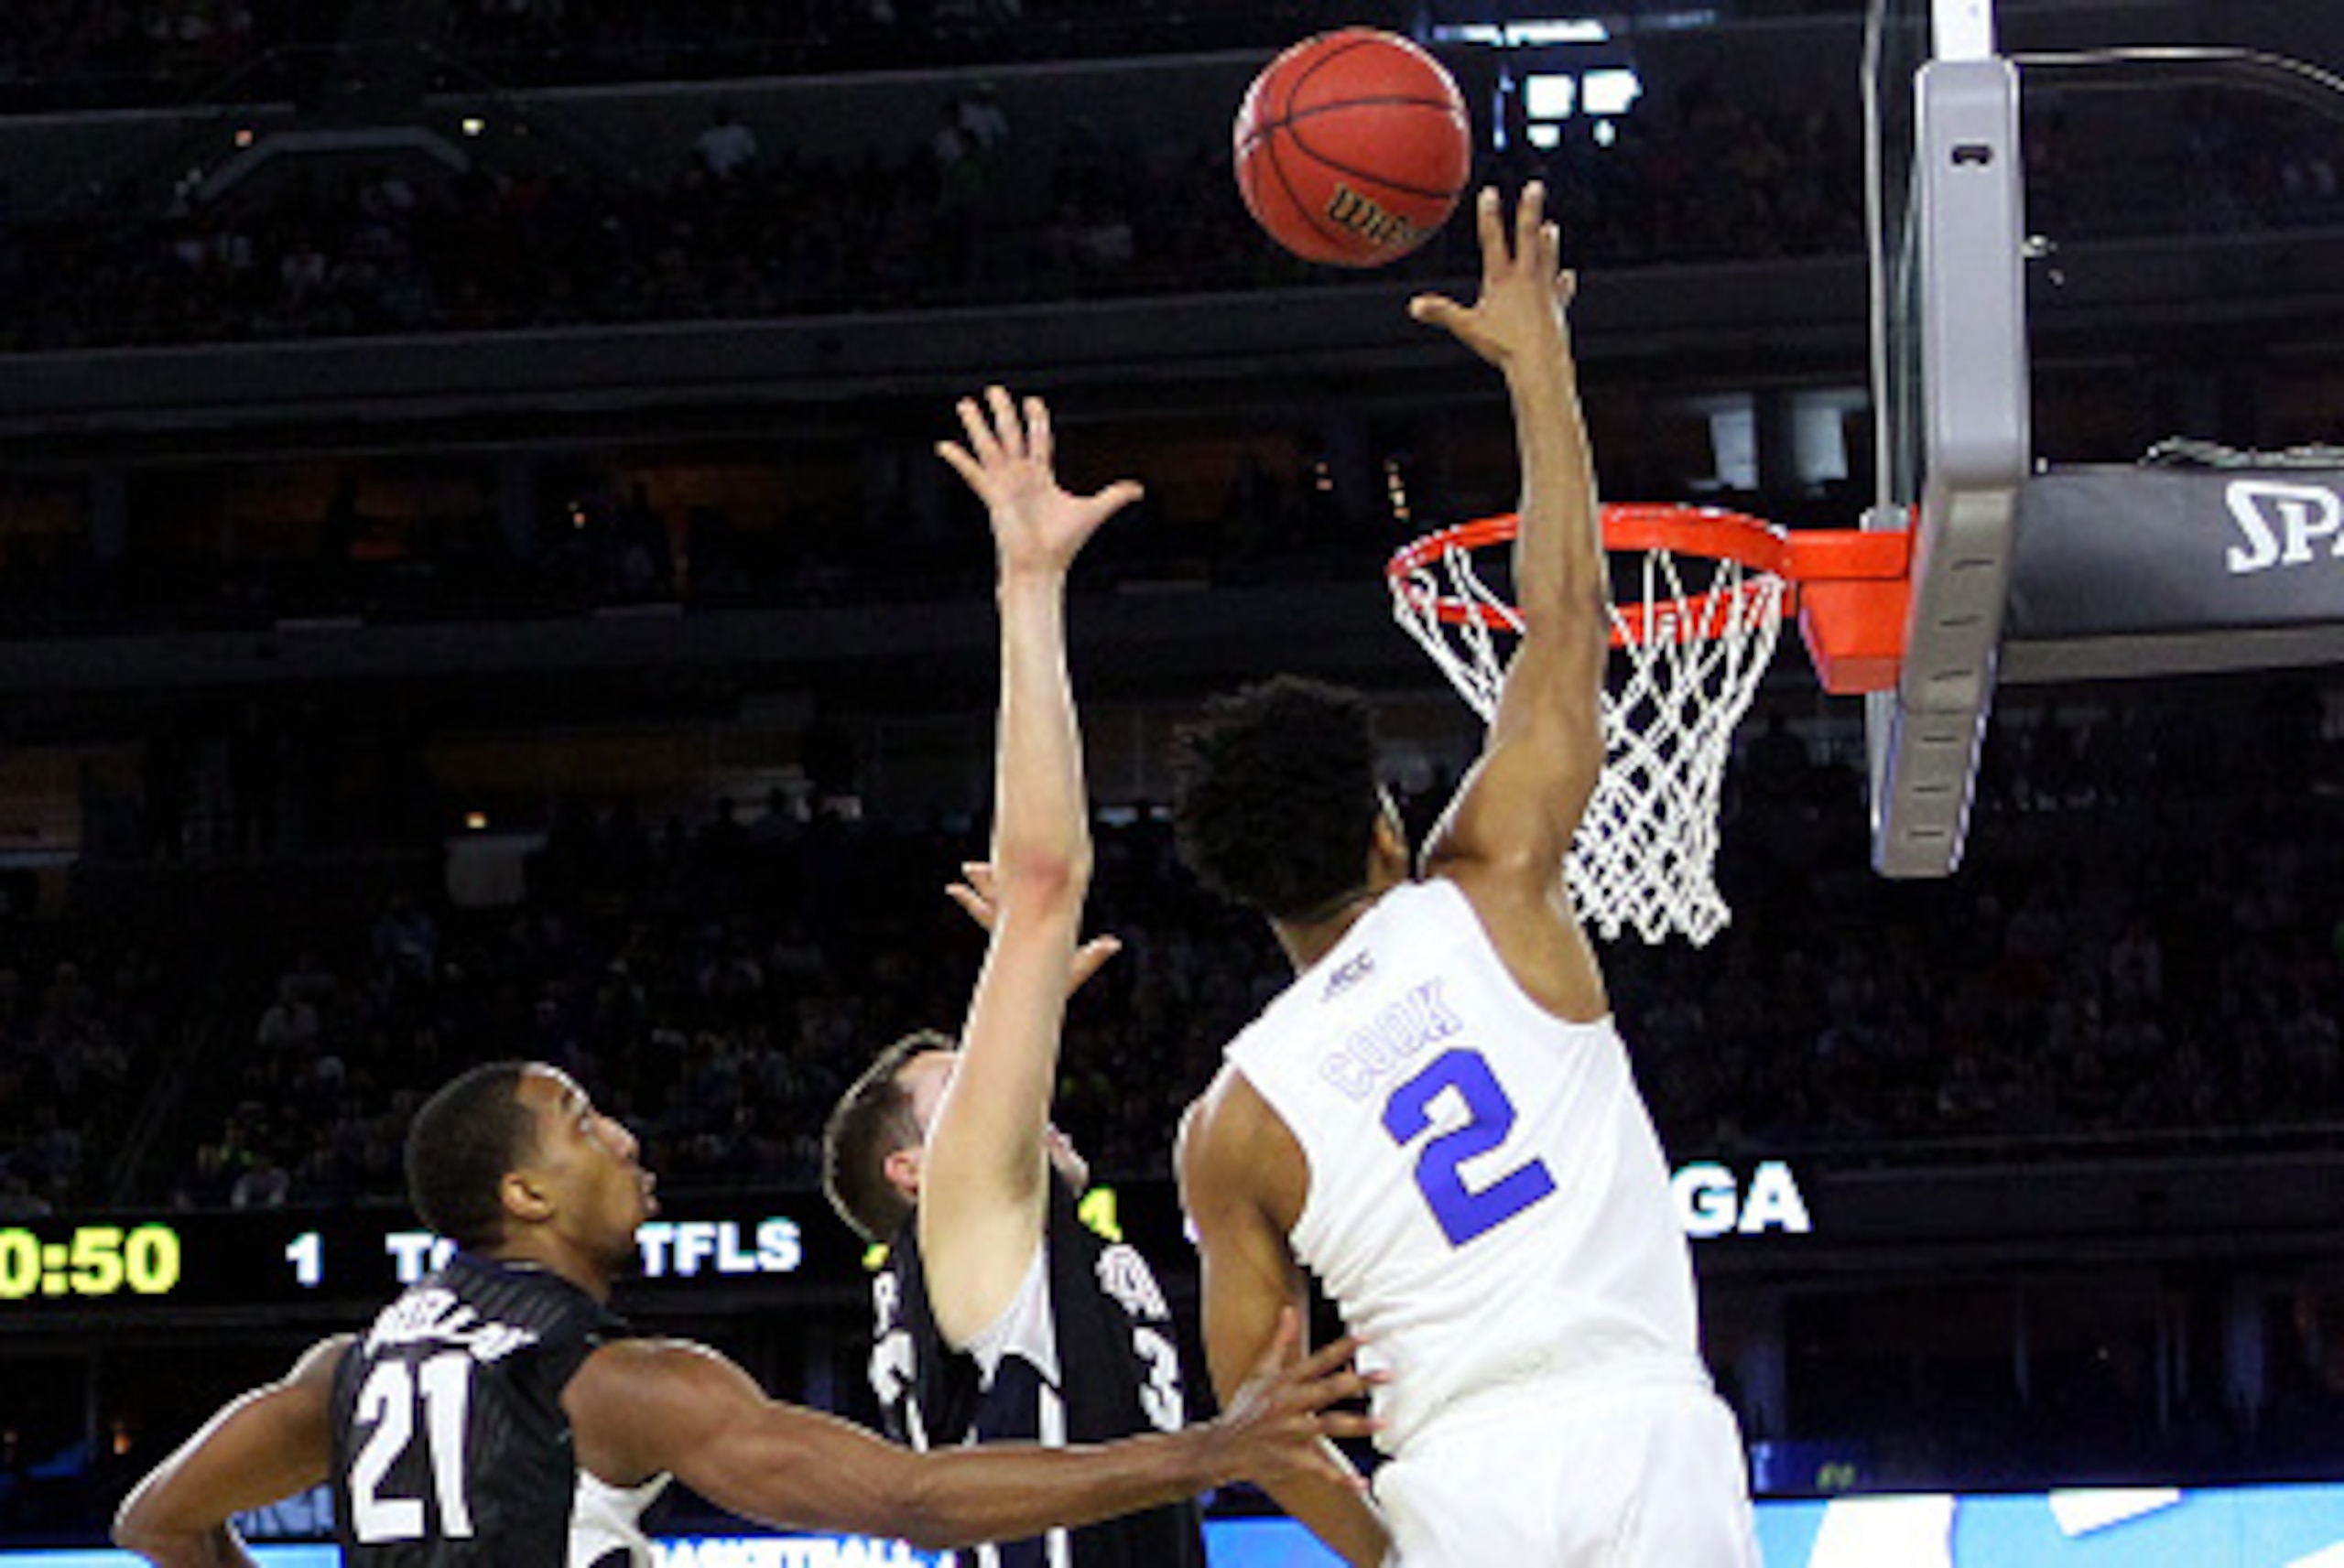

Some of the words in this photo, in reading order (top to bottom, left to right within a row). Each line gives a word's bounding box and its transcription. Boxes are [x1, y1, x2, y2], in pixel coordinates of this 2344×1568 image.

[2226, 481, 2344, 572] SP
[1382, 1048, 1557, 1249] 2
[286, 1230, 323, 1285] 1
[635, 1218, 801, 1277] TFLS
[352, 1349, 474, 1542] 21
